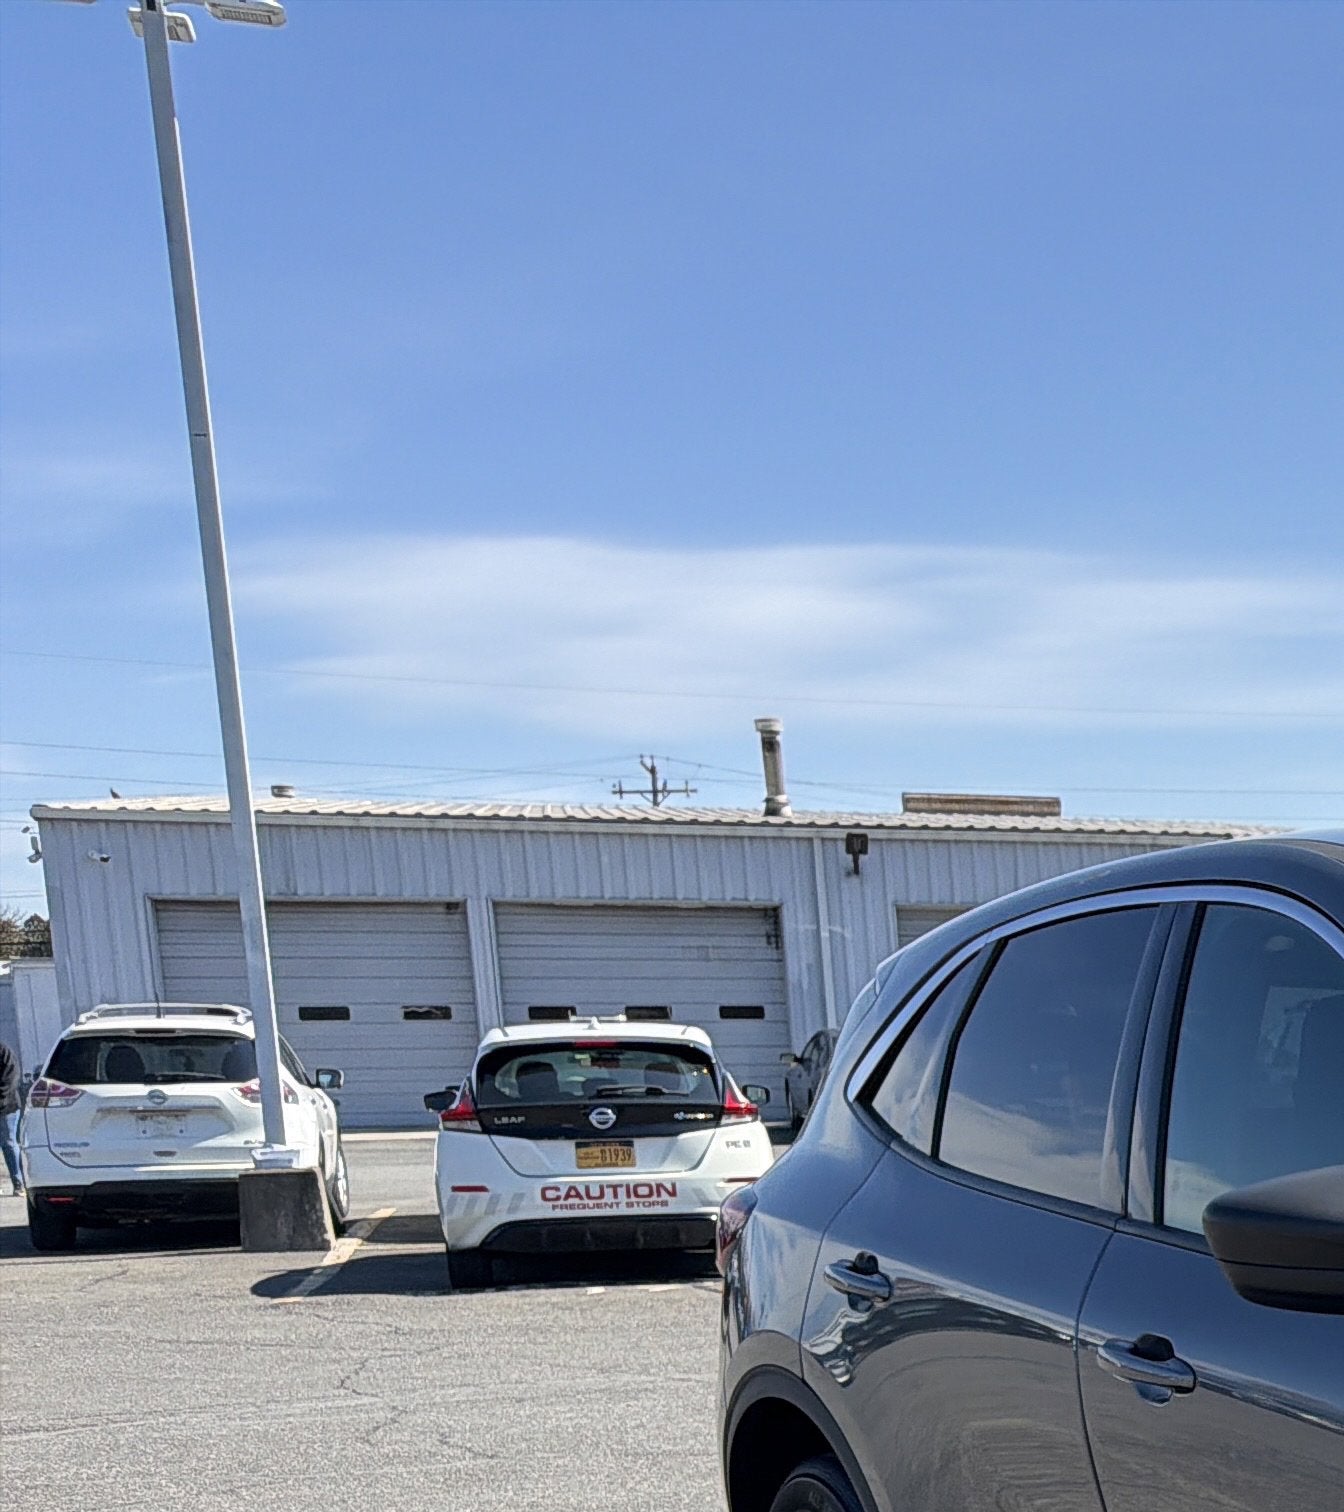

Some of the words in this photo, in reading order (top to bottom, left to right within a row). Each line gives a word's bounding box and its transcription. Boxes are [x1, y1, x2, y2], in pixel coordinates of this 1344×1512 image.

[494, 1115, 526, 1124] LEAF
[540, 1182, 678, 1201] CAUTION
[551, 1201, 621, 1211] FREQUENT
[625, 1199, 669, 1209] STOPS
